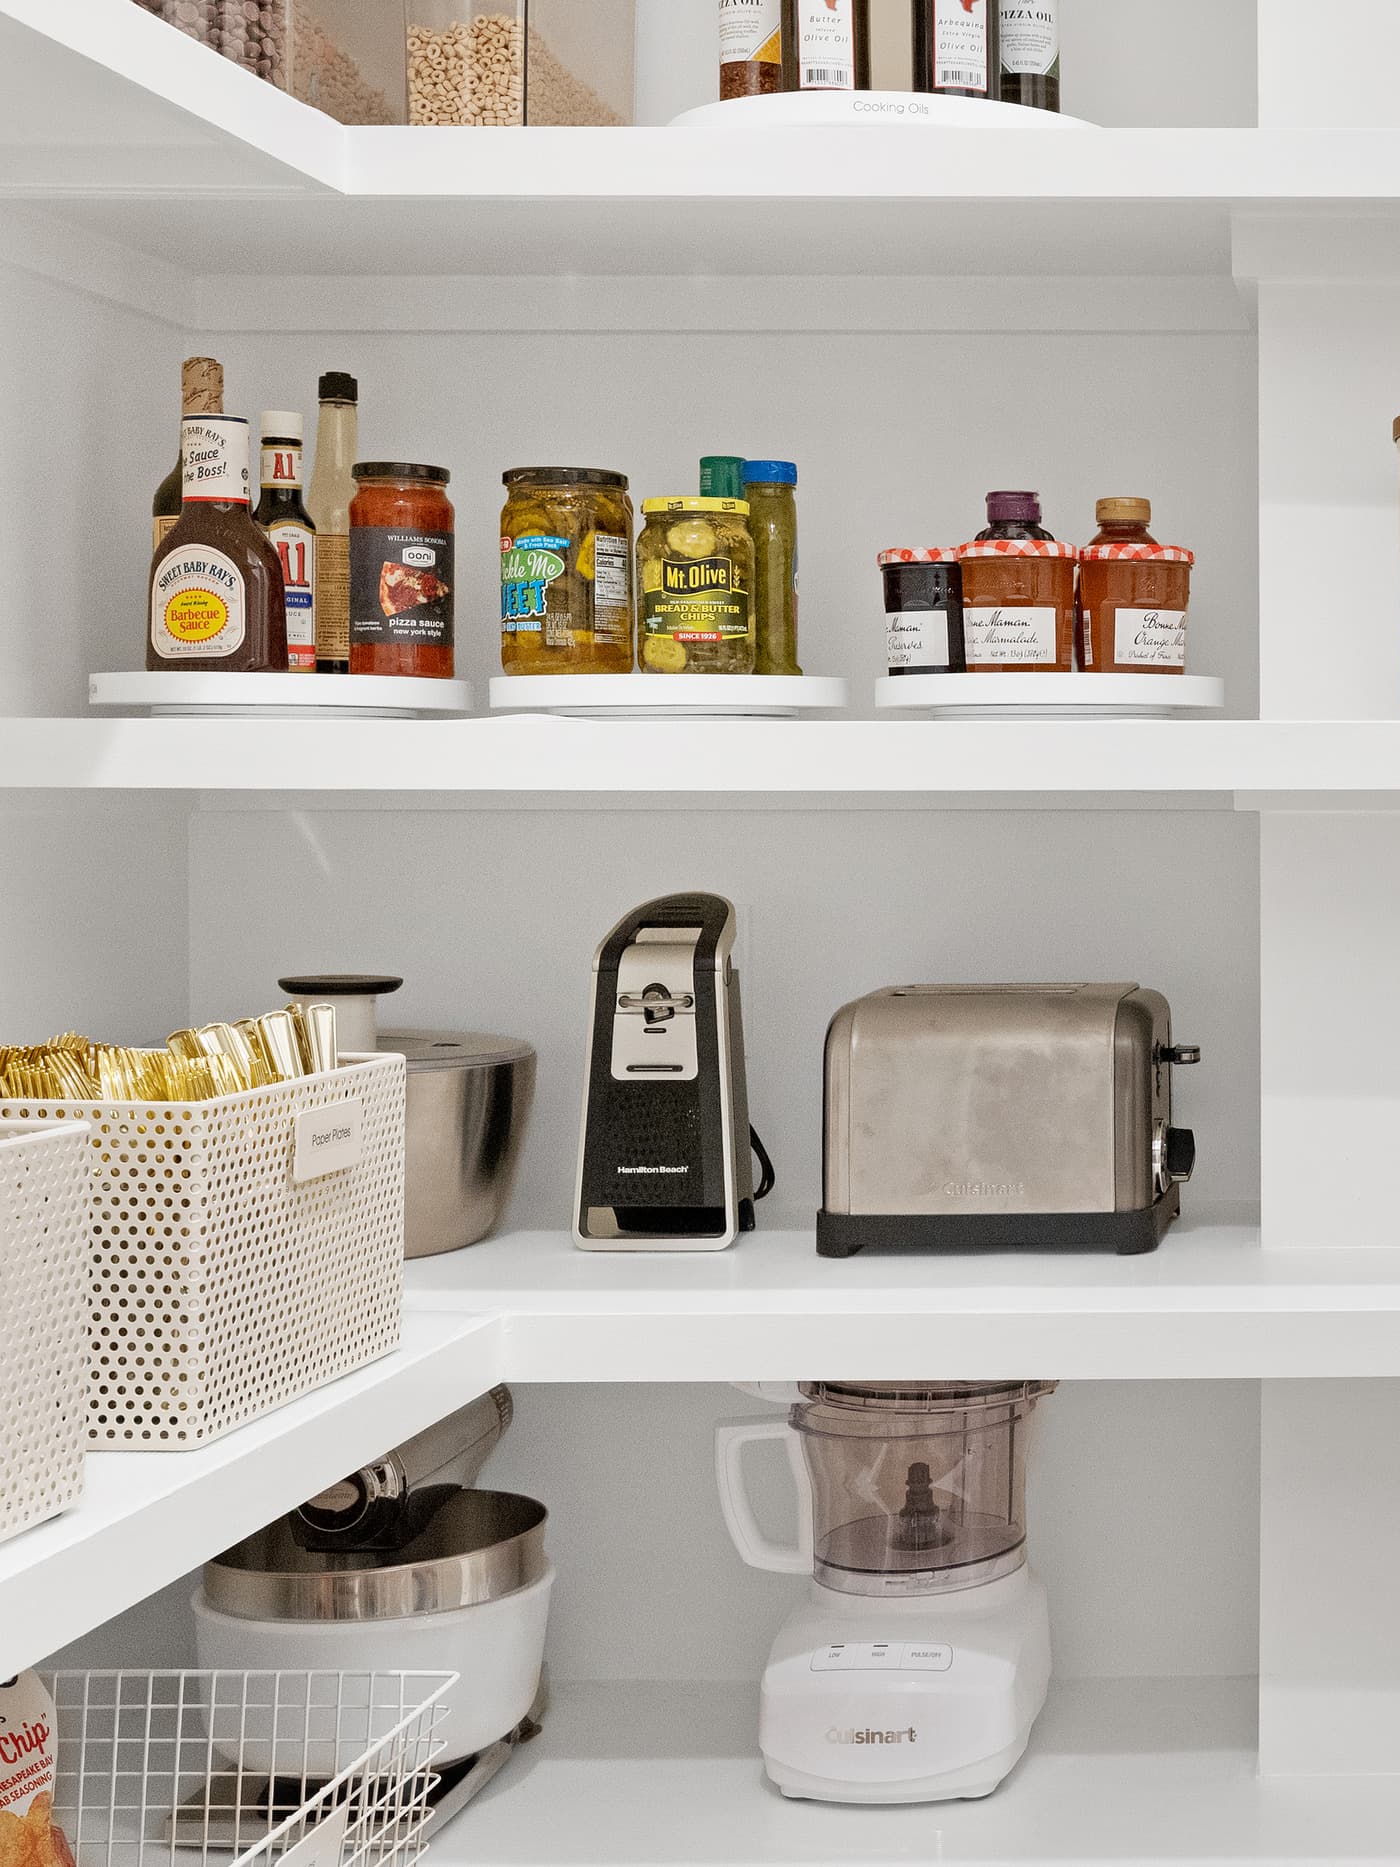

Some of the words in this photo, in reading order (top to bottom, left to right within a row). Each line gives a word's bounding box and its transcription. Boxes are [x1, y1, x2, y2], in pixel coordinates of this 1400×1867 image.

[809, 15, 841, 23] Butter
[938, 18, 984, 30] Arbequina
[804, 34, 830, 42] Olive
[834, 35, 848, 43] Oil
[940, 42, 965, 50] Olive
[970, 44, 983, 53] Oil
[853, 100, 904, 114] Cooking
[908, 102, 929, 114] Oils
[189, 448, 219, 464] Sauce
[197, 462, 227, 479] Boss!
[387, 535, 424, 543] WILLIAMS
[408, 552, 432, 560] ooni
[527, 552, 556, 579] Me
[158, 564, 182, 592] SWEET
[183, 561, 208, 574] BABY
[209, 564, 237, 588] RAY'S
[666, 565, 687, 589] Mt.
[688, 564, 727, 588] Olive
[170, 609, 220, 621] Barbecue
[654, 604, 688, 612] BREAD
[691, 604, 700, 612] &
[702, 604, 740, 614] BUTTER
[389, 617, 417, 627] pizza
[418, 619, 445, 628] sauce
[680, 612, 716, 620] CHIPS
[1142, 611, 1174, 630] Bonne
[179, 620, 210, 634] Sauce
[410, 628, 426, 636] york
[427, 628, 442, 637] style
[1134, 630, 1169, 651] Orange
[617, 1165, 659, 1174] Hamilton
[659, 1165, 688, 1173] Beach
[825, 1725, 917, 1745] Cuisinart
[39, 1754, 54, 1770] BAY
[10, 1771, 53, 1802] SEASONING
